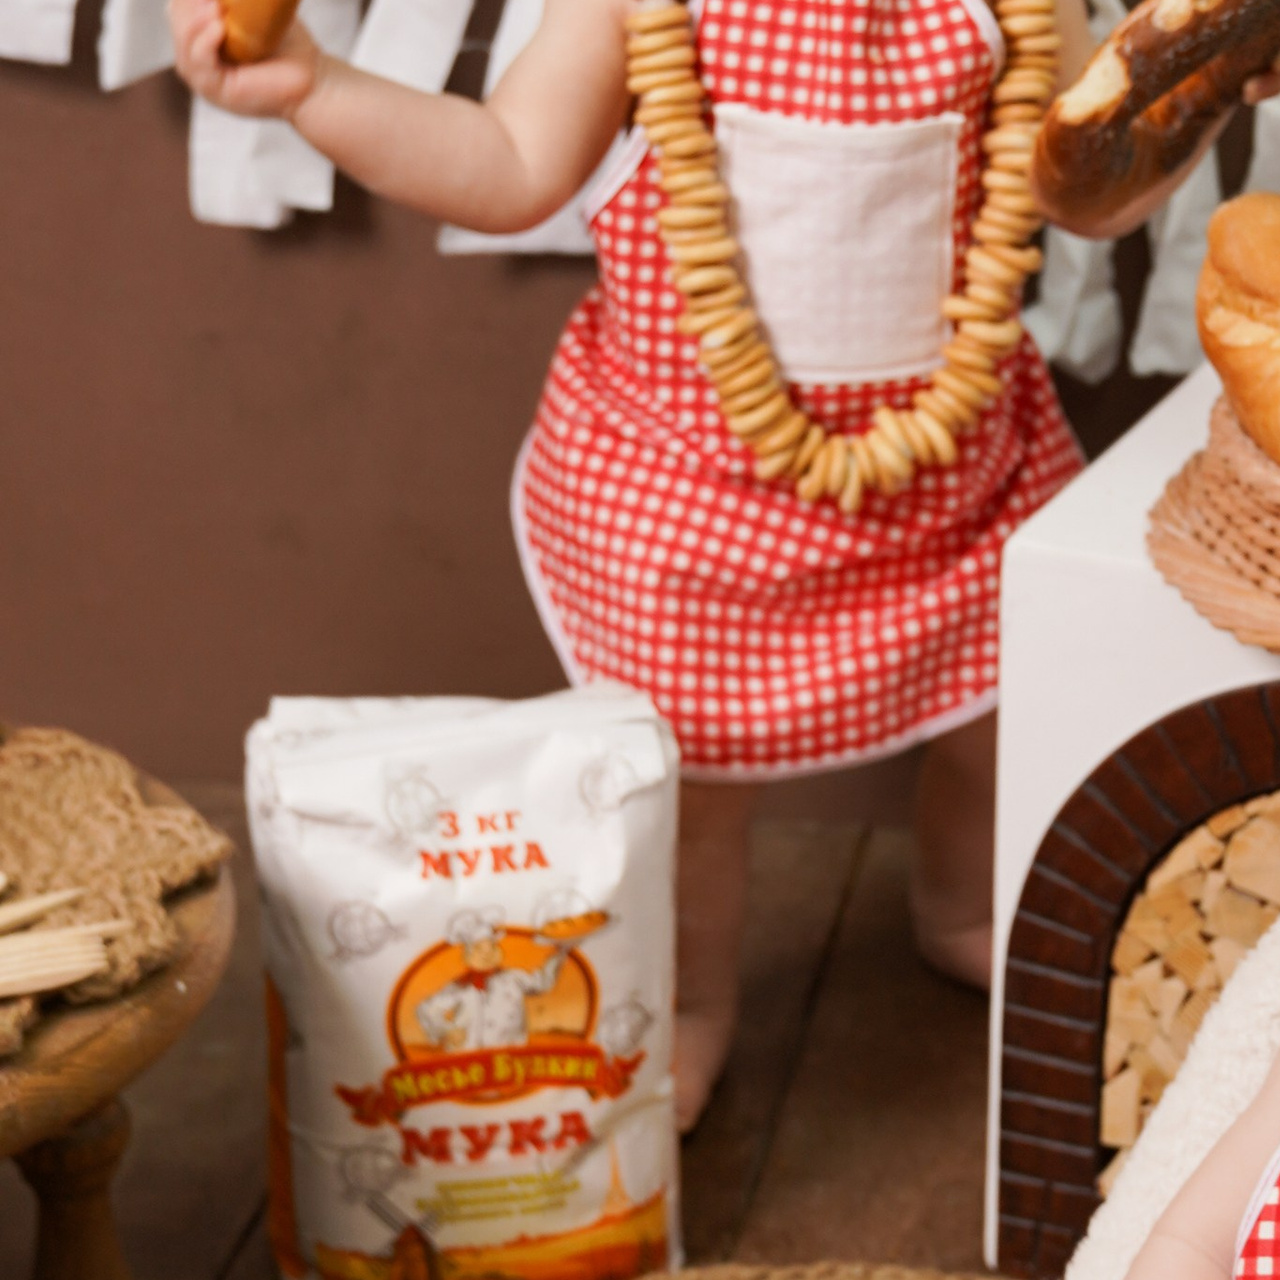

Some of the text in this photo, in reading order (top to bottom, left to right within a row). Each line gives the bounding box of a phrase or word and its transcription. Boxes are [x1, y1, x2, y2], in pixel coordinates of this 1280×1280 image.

[437, 810, 459, 839] 3
[419, 841, 549, 879] МУКА
[401, 1111, 591, 1165] МУКА
